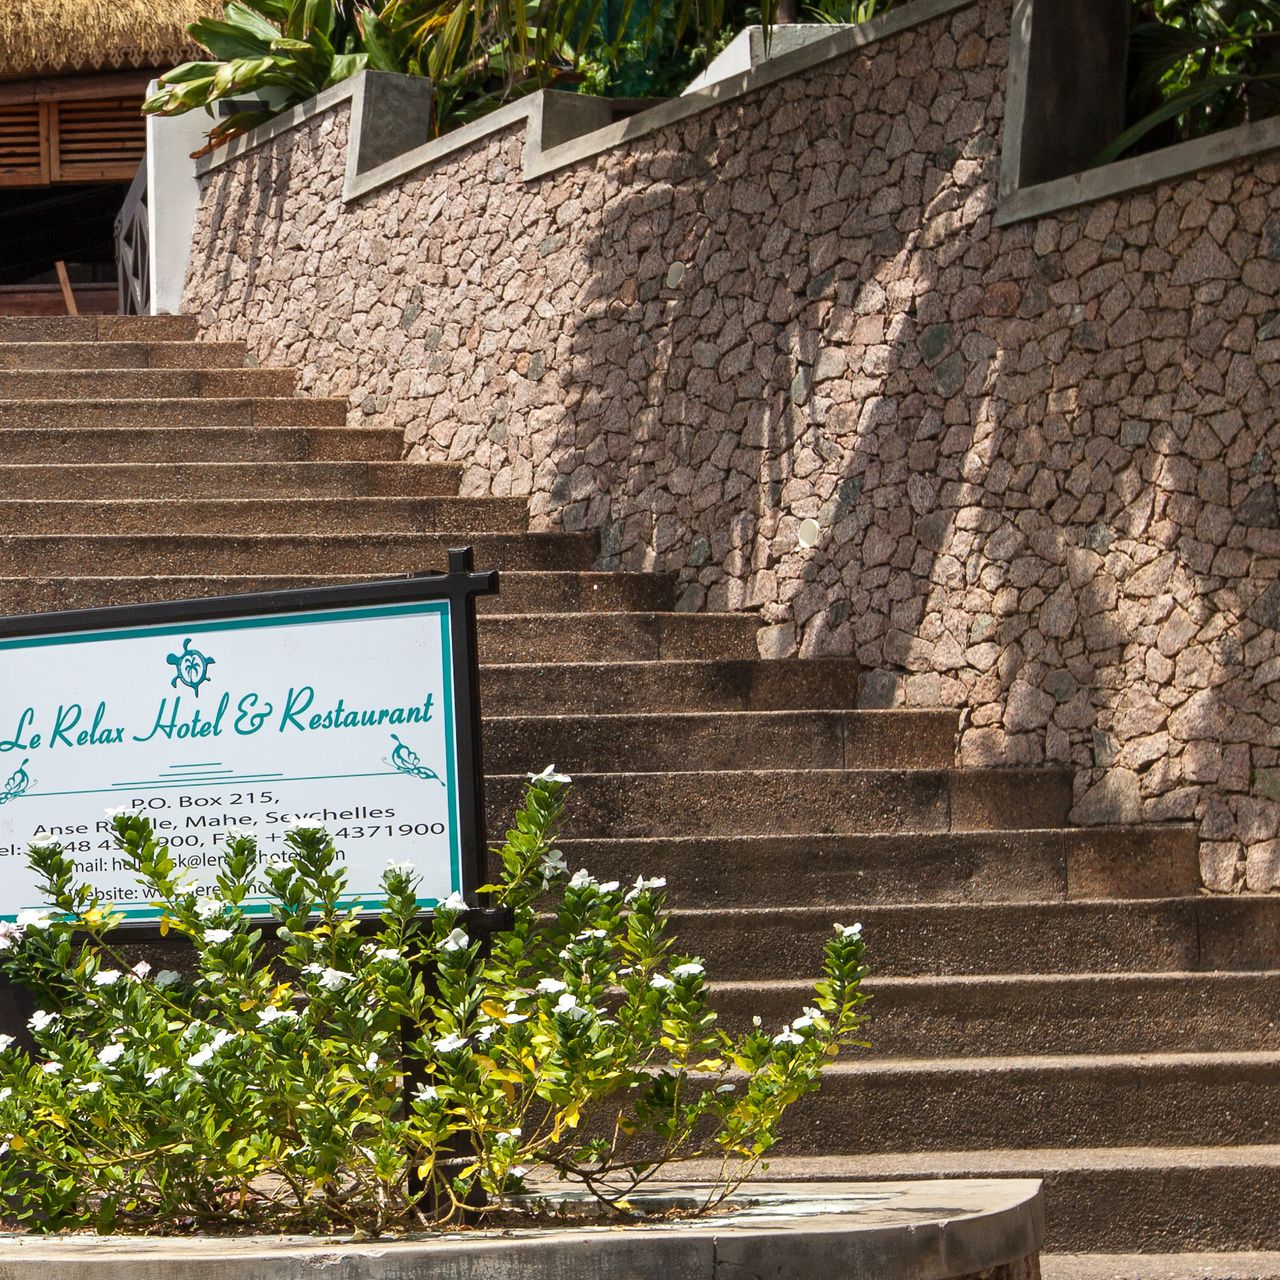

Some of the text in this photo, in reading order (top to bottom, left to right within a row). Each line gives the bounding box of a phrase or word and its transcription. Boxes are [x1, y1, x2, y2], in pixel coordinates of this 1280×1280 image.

[49, 701, 125, 748] Relax
[132, 691, 230, 742] Hotel
[234, 692, 273, 735] &
[279, 685, 434, 733] Restaurant
[131, 791, 280, 810] P.O. Box 215,
[33, 823, 89, 837] Anse
[96, 817, 178, 833] Rle,
[185, 813, 258, 828] Mahe,
[335, 822, 446, 839] 4371900
